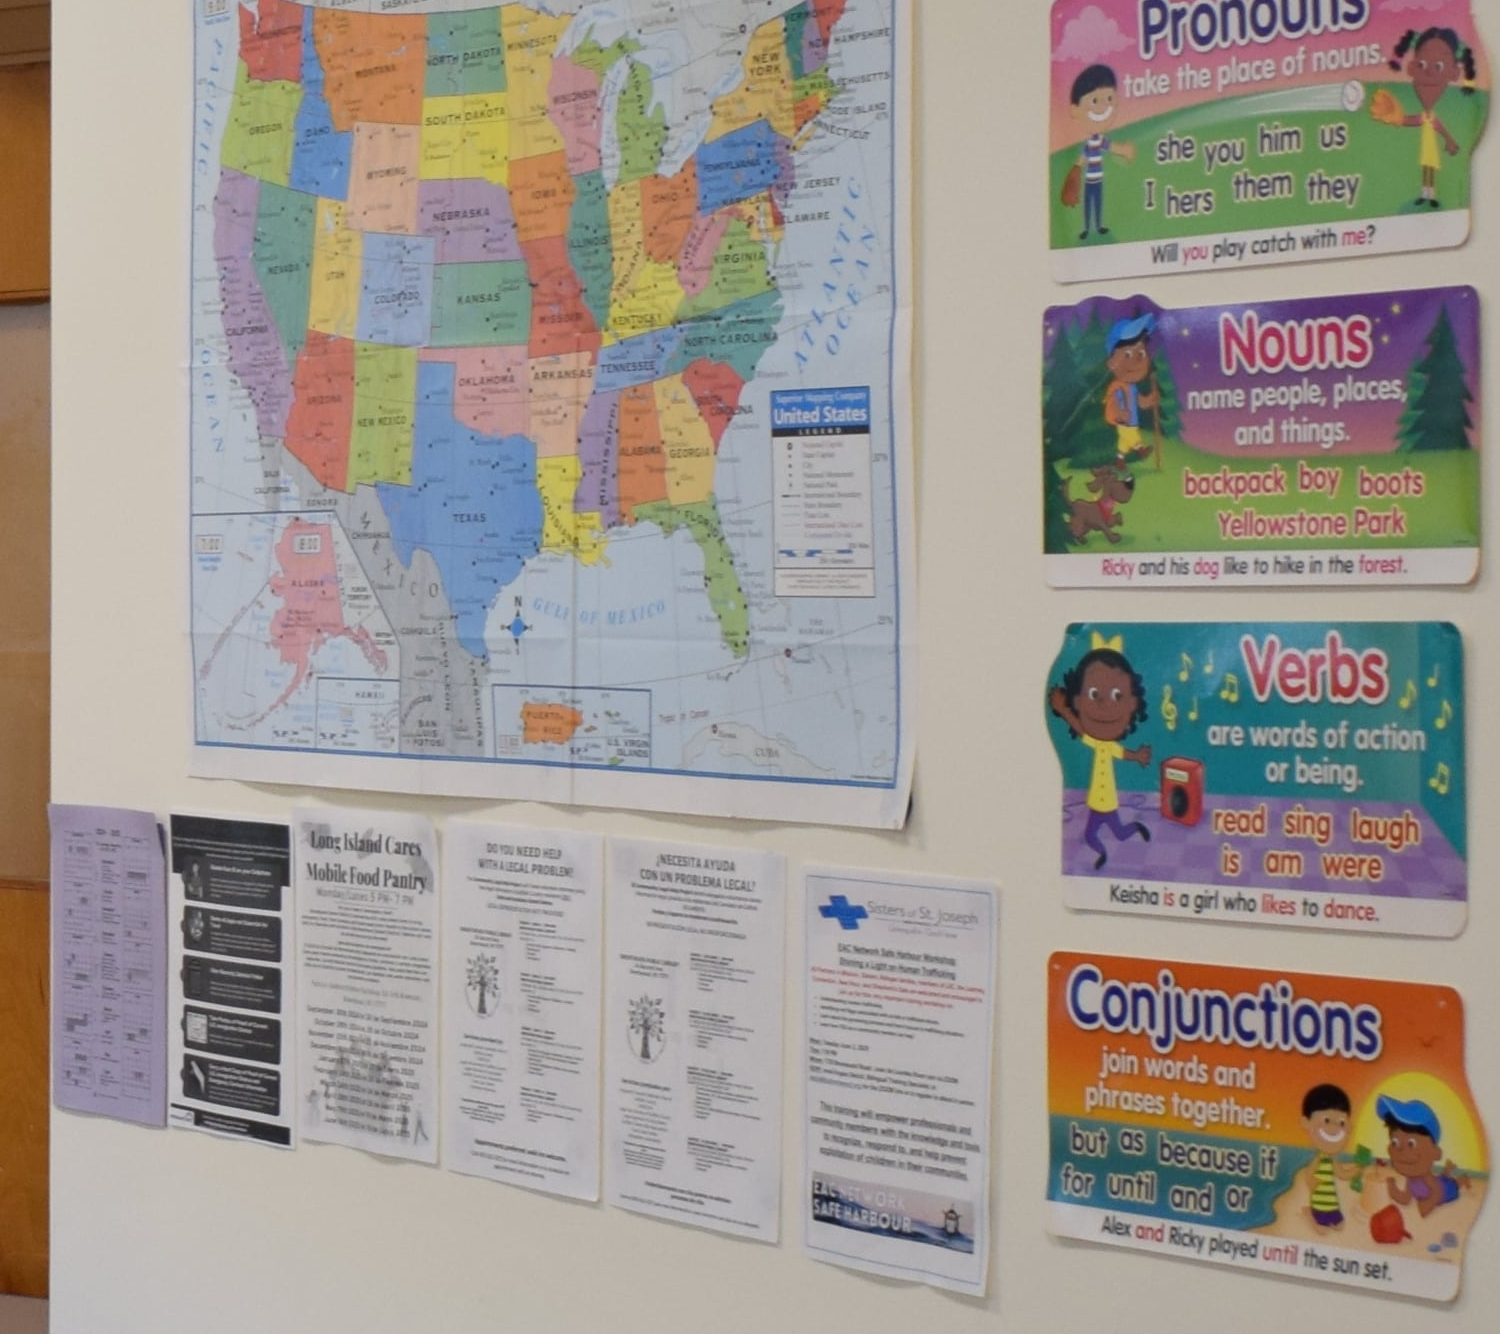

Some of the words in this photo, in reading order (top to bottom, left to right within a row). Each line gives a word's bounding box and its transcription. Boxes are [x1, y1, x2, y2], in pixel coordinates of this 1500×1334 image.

[750, 65, 781, 76] YORK
[752, 53, 779, 64] NEW
[1124, 72, 1169, 98] take
[1176, 67, 1211, 91] the
[1217, 57, 1276, 91] place
[1282, 51, 1305, 75] of
[1312, 43, 1386, 72] nouns.
[425, 113, 461, 126] SOUTH
[465, 107, 505, 121] DAKOTA
[432, 208, 490, 221] NEBRASKA
[456, 293, 500, 304] KANSAS
[1221, 311, 1372, 374] Nouns
[459, 375, 515, 386] OKLAHOMA
[534, 369, 592, 380] ARKANSAS
[1187, 387, 1244, 410] name
[1251, 382, 1327, 412] people,
[1334, 376, 1407, 407] places,
[774, 406, 820, 424] United
[823, 406, 867, 422] States
[1235, 421, 1276, 447] and
[1280, 418, 1351, 449] things.
[453, 513, 486, 523] TEXAS
[1240, 631, 1389, 703] Verbs
[1208, 725, 1244, 747] are
[1250, 723, 1318, 750] words
[1323, 721, 1348, 748] of
[1354, 722, 1426, 751] action
[1265, 763, 1290, 784] or
[1295, 759, 1364, 792] being.
[311, 830, 341, 854] Long
[344, 832, 382, 853] Island
[385, 835, 422, 856] Cares
[306, 862, 347, 883] Mobile
[350, 866, 380, 887] Food
[384, 869, 427, 895] Pantry
[867, 901, 904, 917] Sisters
[936, 908, 978, 925] Joseph
[1068, 964, 1382, 1060] Conjunctions
[1100, 1046, 1138, 1079] join
[1144, 1053, 1208, 1085] words
[1214, 1060, 1256, 1089] and
[1084, 1083, 1166, 1115] phrases
[1172, 1092, 1270, 1129] together.
[814, 1199, 841, 1218] SAFE
[845, 1207, 912, 1232] HARBOUR
